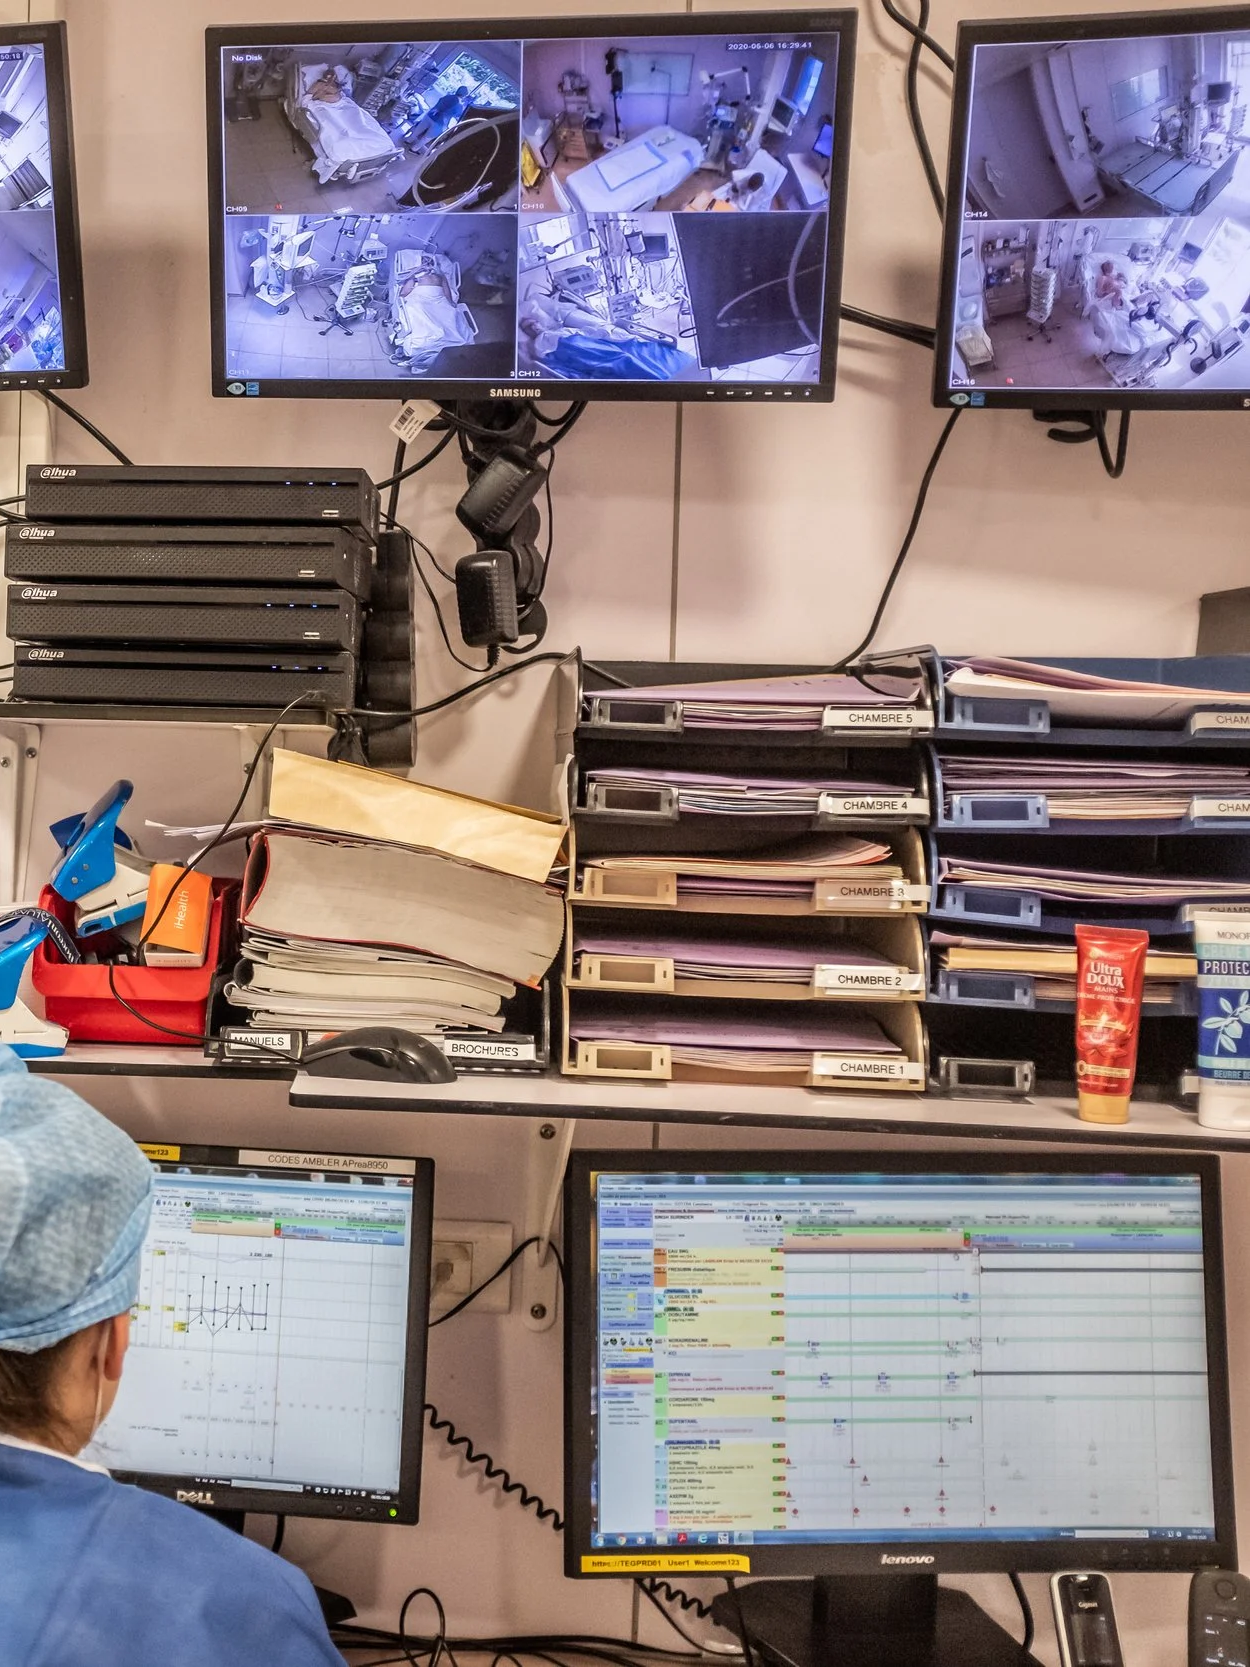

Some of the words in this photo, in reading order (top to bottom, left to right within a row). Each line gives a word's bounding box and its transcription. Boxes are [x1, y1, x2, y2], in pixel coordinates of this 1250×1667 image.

[522, 202, 544, 210] CH10
[490, 388, 541, 398] SAMSUNG
[848, 713, 902, 724] CHAMBRE
[904, 713, 913, 724] 5
[843, 801, 898, 811] CHAMBRE
[899, 801, 908, 811] 4
[840, 886, 896, 897] CHAMBRE
[897, 887, 905, 897] 3
[174, 889, 190, 930] iHealth
[1090, 961, 1123, 976] Ultra
[838, 974, 893, 985] CHAMBRE
[894, 976, 902, 986] 2
[1086, 972, 1124, 989] DOUX
[1094, 985, 1119, 994] MAINS
[234, 1035, 284, 1047] MANUELS
[452, 1043, 519, 1057] BROCHURES
[840, 1063, 896, 1074] CHAMBRE
[898, 1064, 904, 1075] 1
[268, 1154, 301, 1166] CODES
[302, 1156, 340, 1168] AMBLER
[341, 1158, 389, 1171] APrea8950
[176, 1490, 215, 1504] DELL
[668, 1559, 690, 1567] User1
[694, 1559, 740, 1567] Welcome123
[880, 1553, 935, 1565] lenovo
